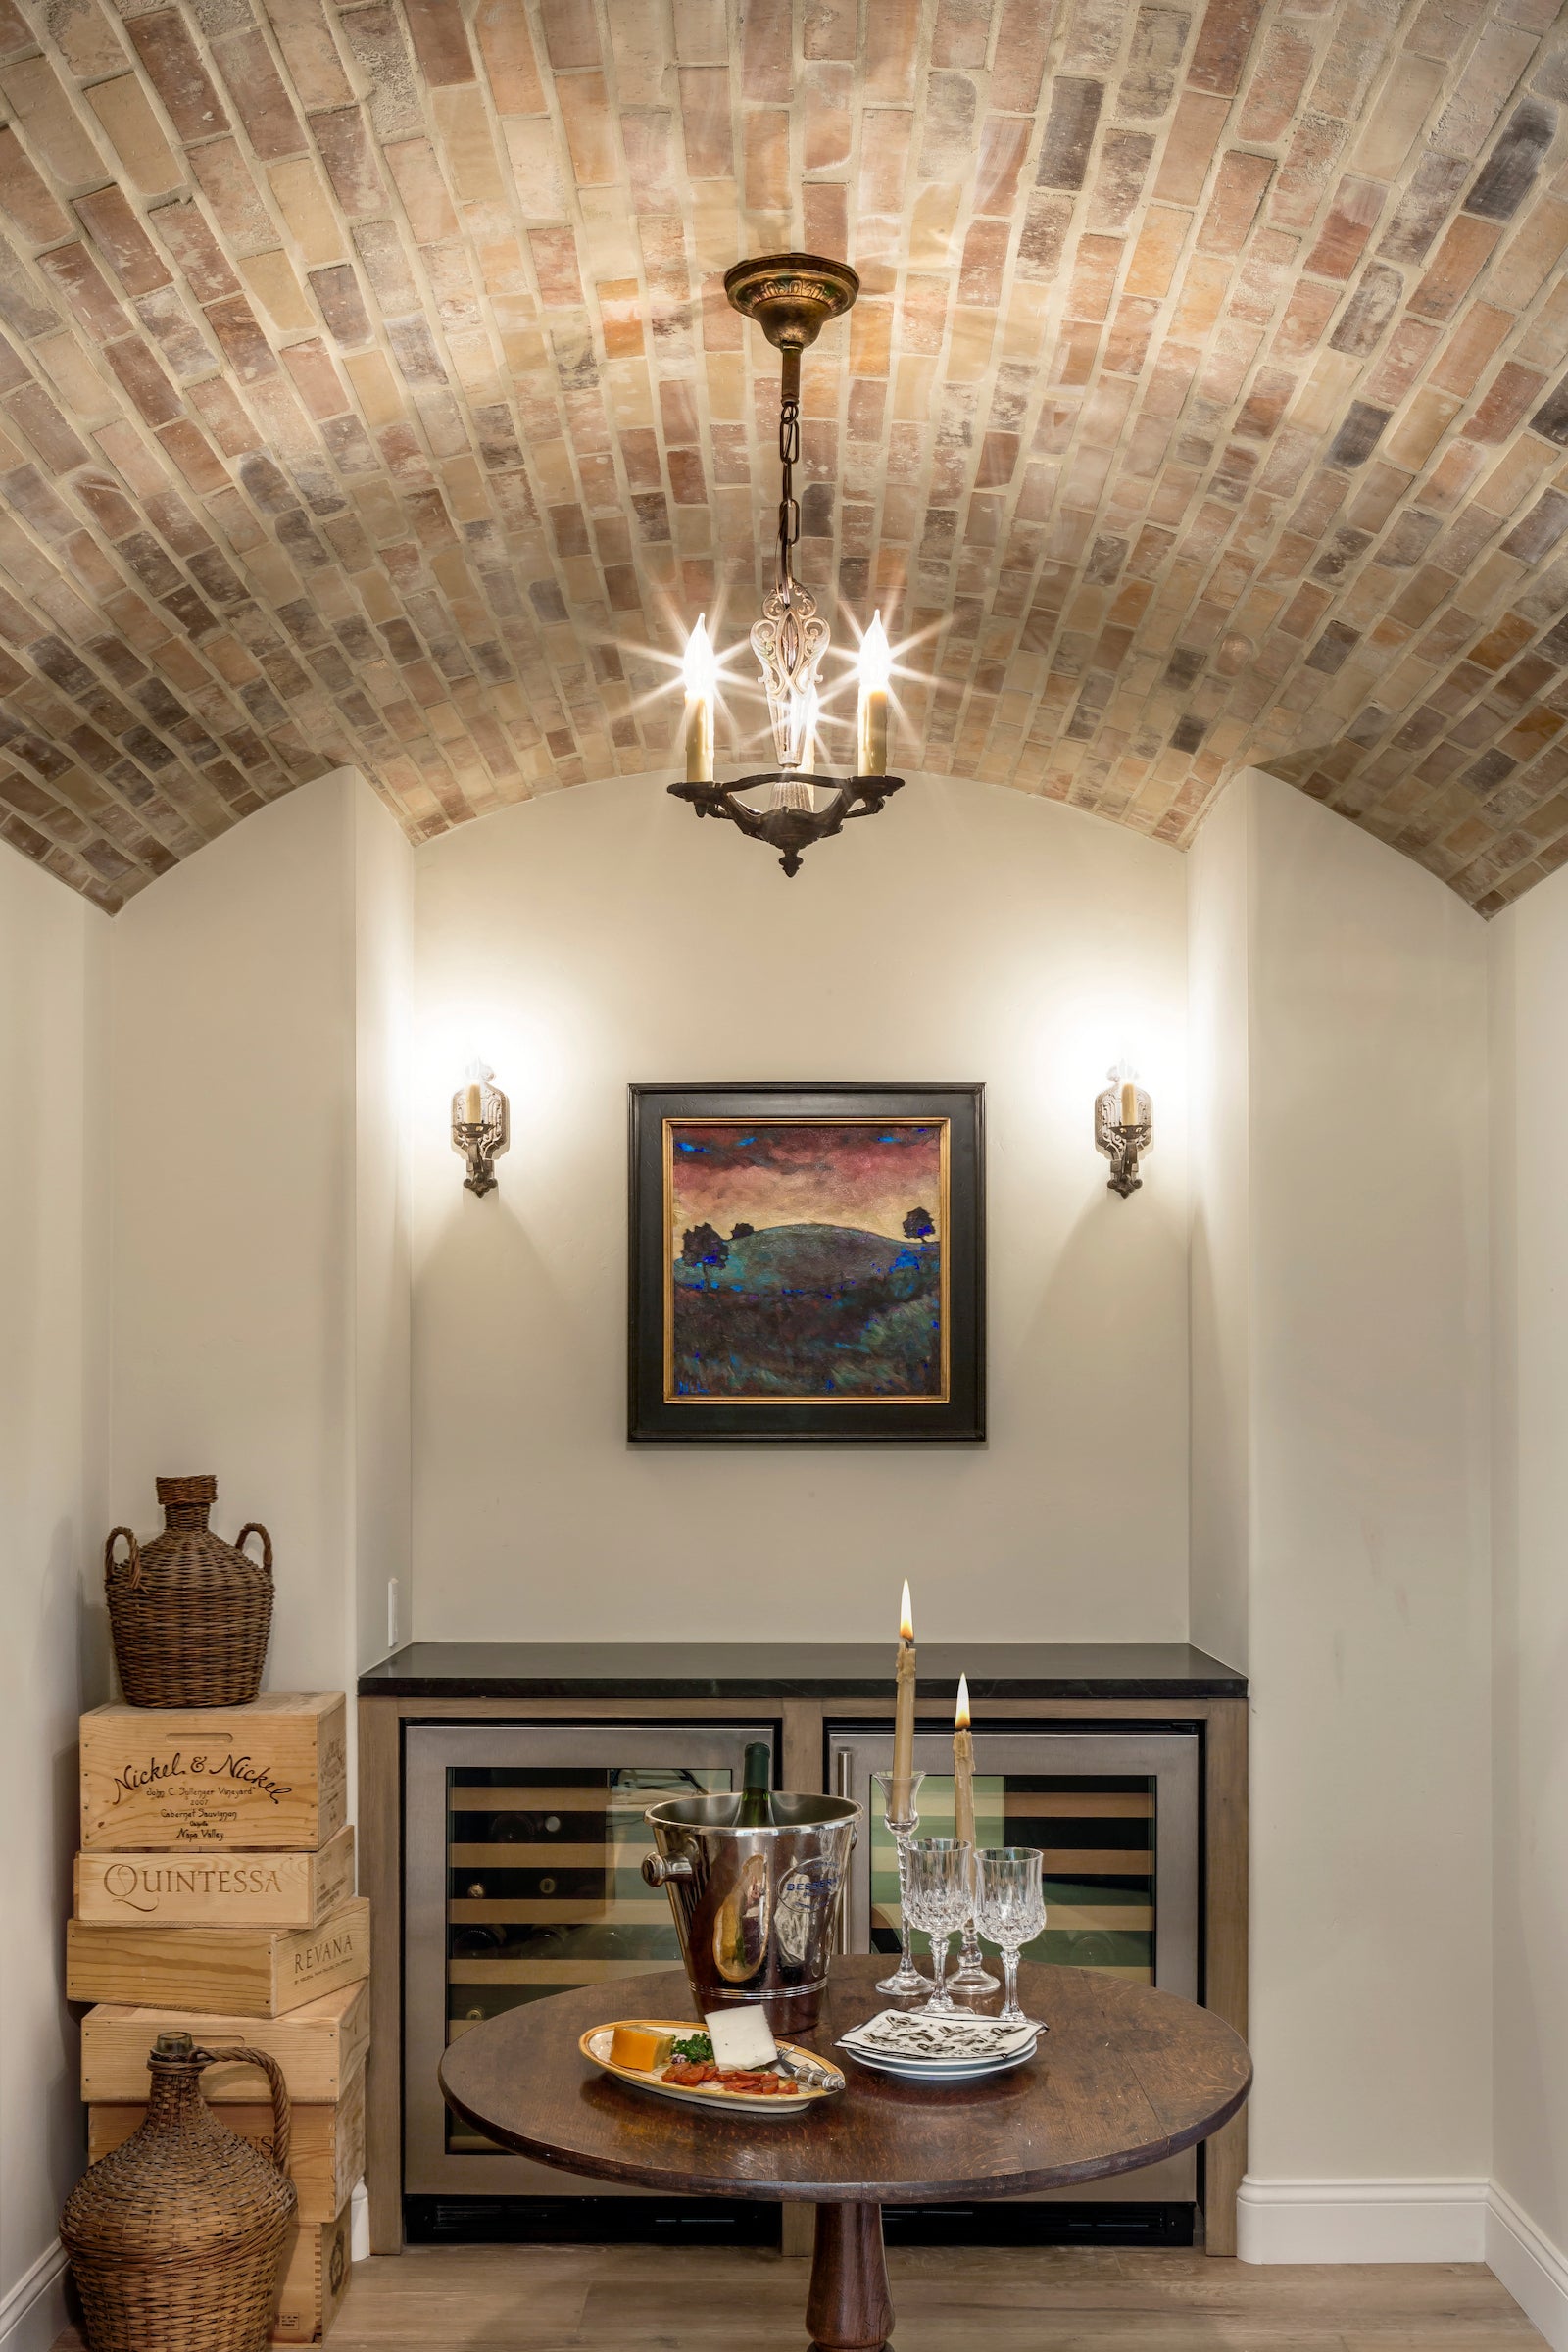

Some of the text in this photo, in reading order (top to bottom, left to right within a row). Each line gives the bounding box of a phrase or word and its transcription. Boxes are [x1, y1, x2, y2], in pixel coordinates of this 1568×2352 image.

[113, 1752, 186, 1805] Nickel
[190, 1755, 208, 1773] &
[209, 1753, 292, 1805] Nickel
[160, 1808, 237, 1821] Cabernet Sauvignon
[176, 1828, 224, 1842] Napa Valley
[104, 1864, 282, 1912] QUINTESSA
[295, 1934, 353, 1973] REVANA
